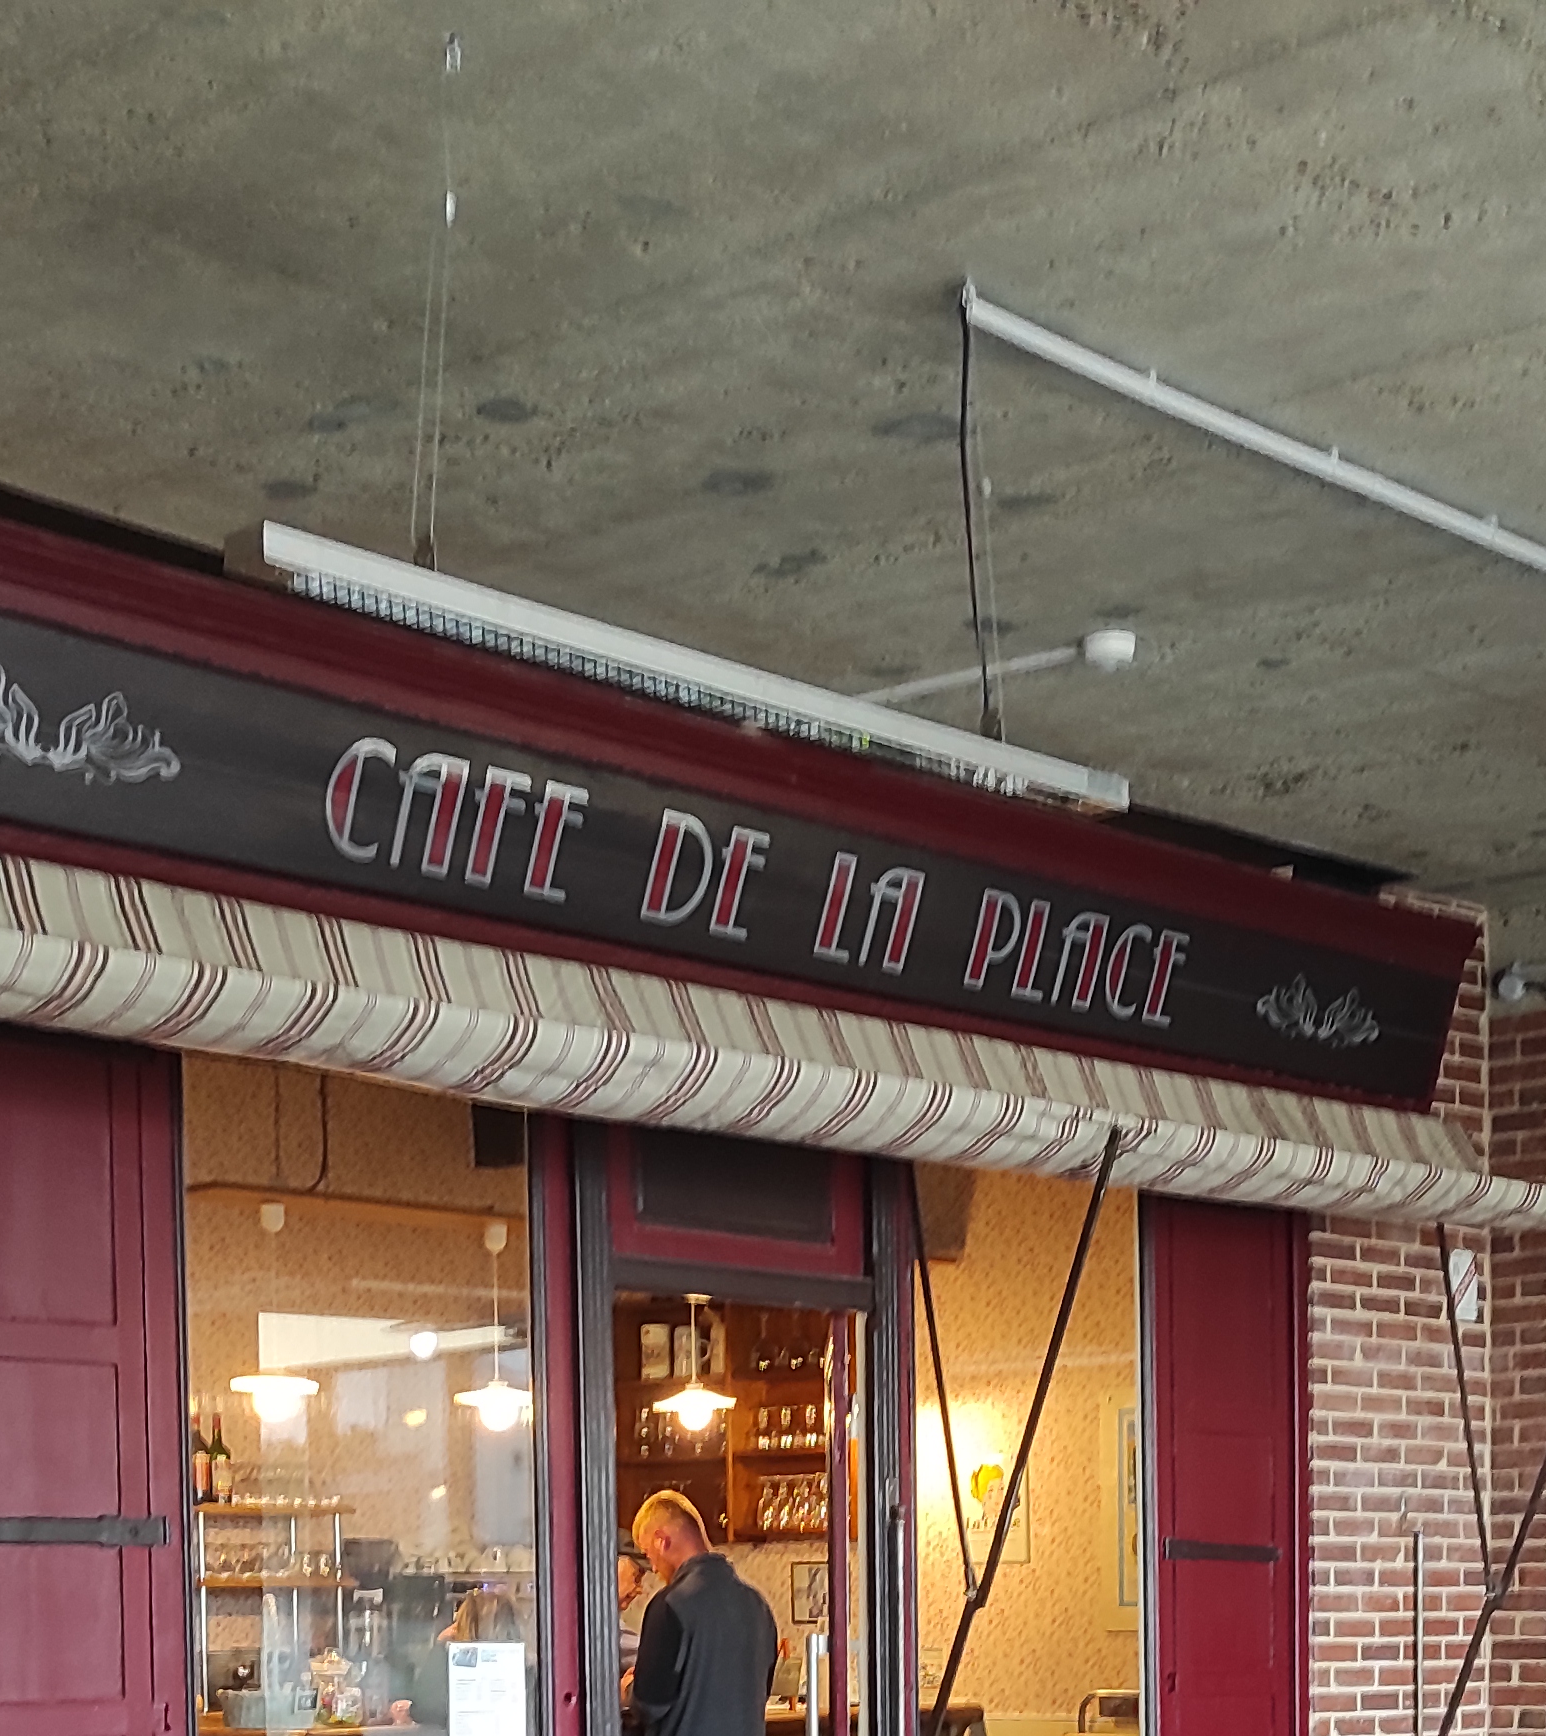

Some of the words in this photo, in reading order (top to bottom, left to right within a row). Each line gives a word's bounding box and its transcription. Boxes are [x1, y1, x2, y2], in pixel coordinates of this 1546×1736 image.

[325, 736, 589, 903] CAFE
[640, 808, 771, 941] DE
[813, 851, 926, 975] LA
[963, 888, 1191, 1029] PLACE
